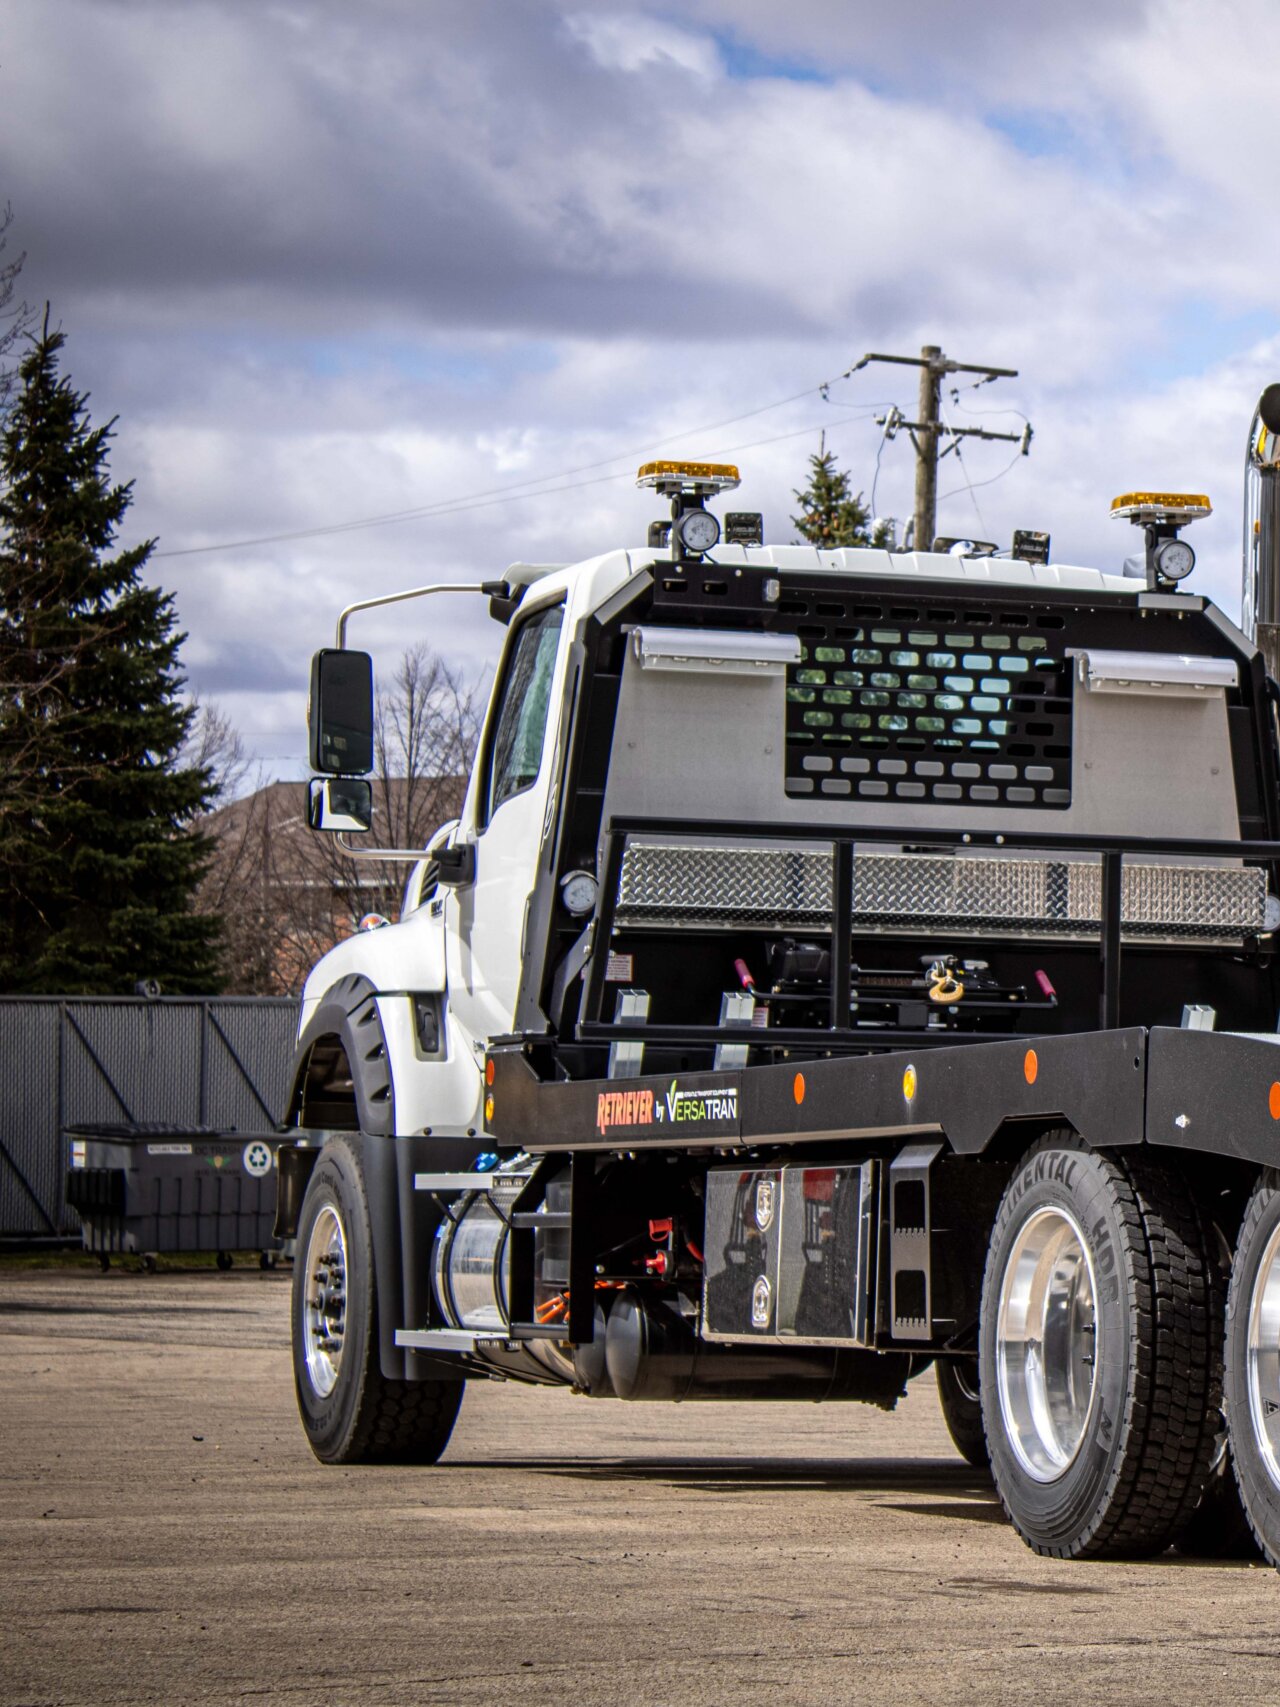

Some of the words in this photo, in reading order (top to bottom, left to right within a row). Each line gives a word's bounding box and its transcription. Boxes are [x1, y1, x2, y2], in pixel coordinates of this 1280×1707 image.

[597, 1090, 653, 1135] RETRIEVER
[655, 1101, 665, 1122] by
[666, 1089, 737, 1122] VERSATRAN
